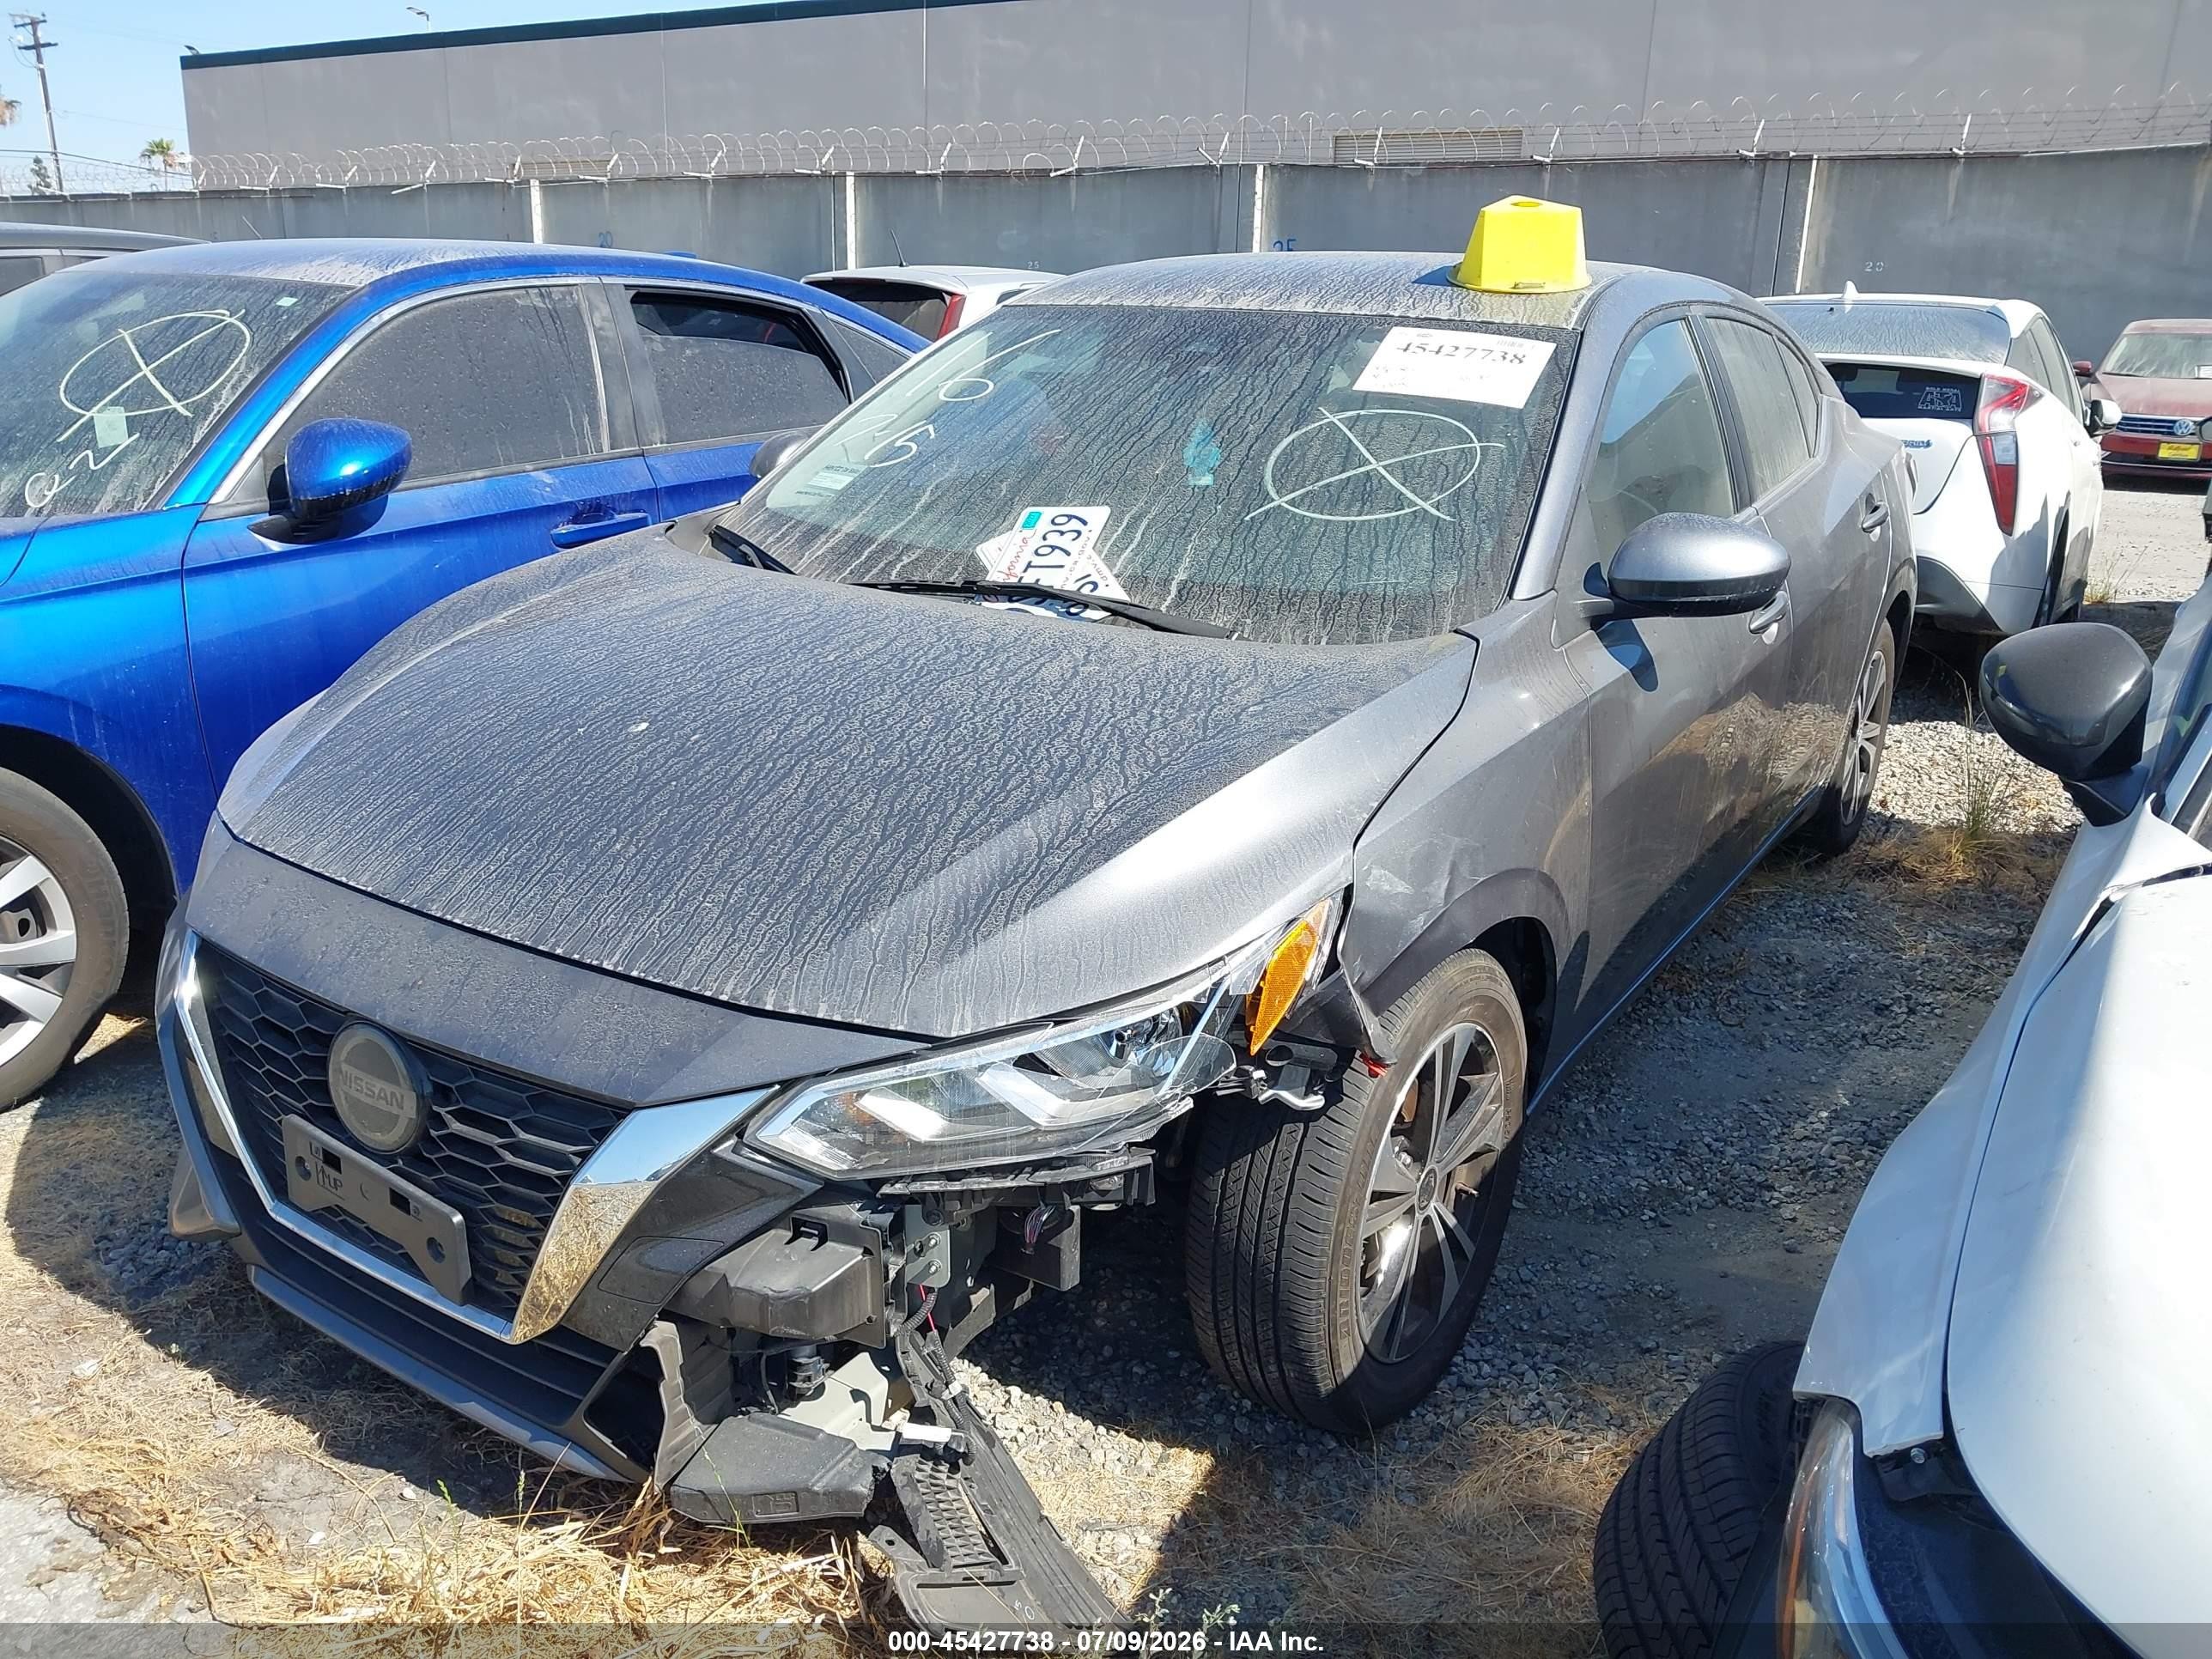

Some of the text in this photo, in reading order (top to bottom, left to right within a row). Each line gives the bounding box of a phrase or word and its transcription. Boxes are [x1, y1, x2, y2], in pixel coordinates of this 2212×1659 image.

[1864, 260, 1885, 272] 20
[1396, 341, 1526, 365] 45427738
[343, 1069, 404, 1111] NISSAN
[327, 1174, 343, 1191] UP
